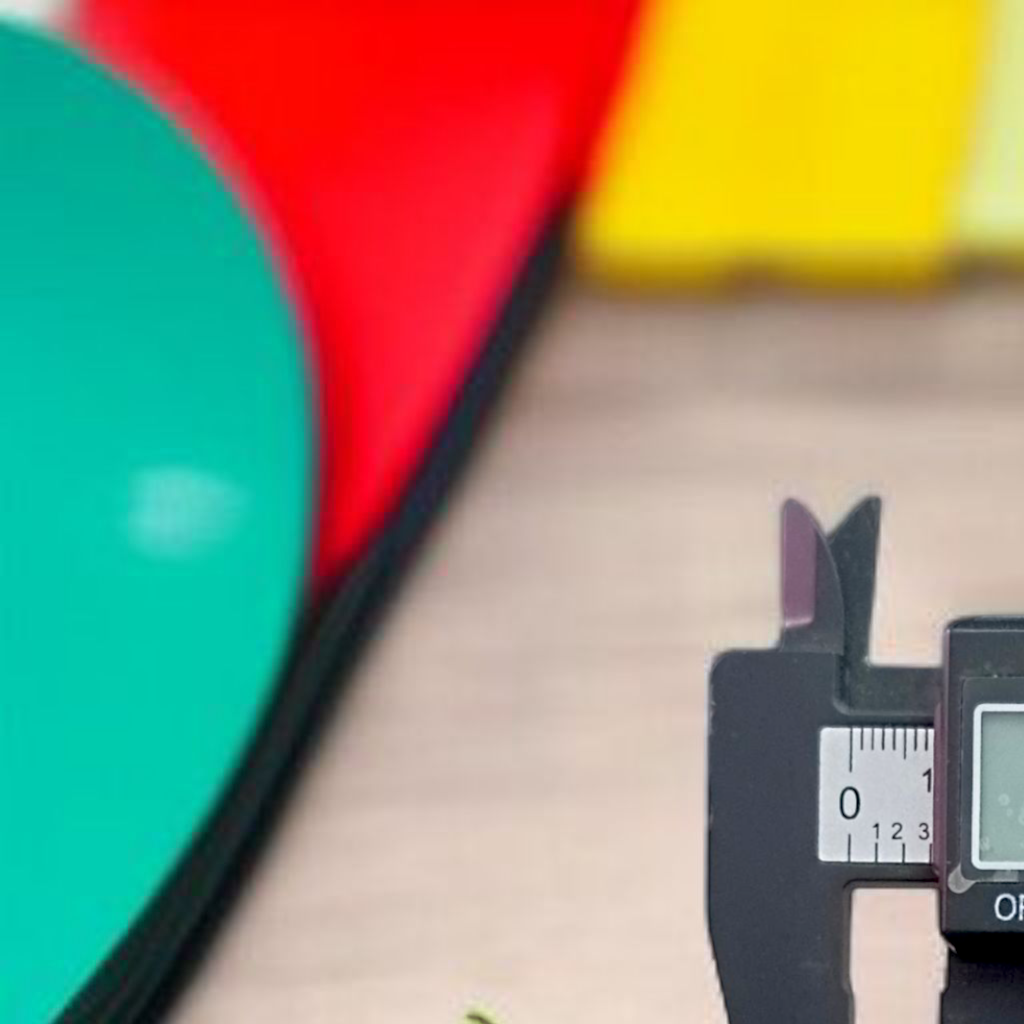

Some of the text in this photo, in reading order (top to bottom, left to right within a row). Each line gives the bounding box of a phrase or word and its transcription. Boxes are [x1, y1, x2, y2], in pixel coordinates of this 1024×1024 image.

[838, 786, 861, 820] 0
[872, 822, 930, 840] 1 2 3
